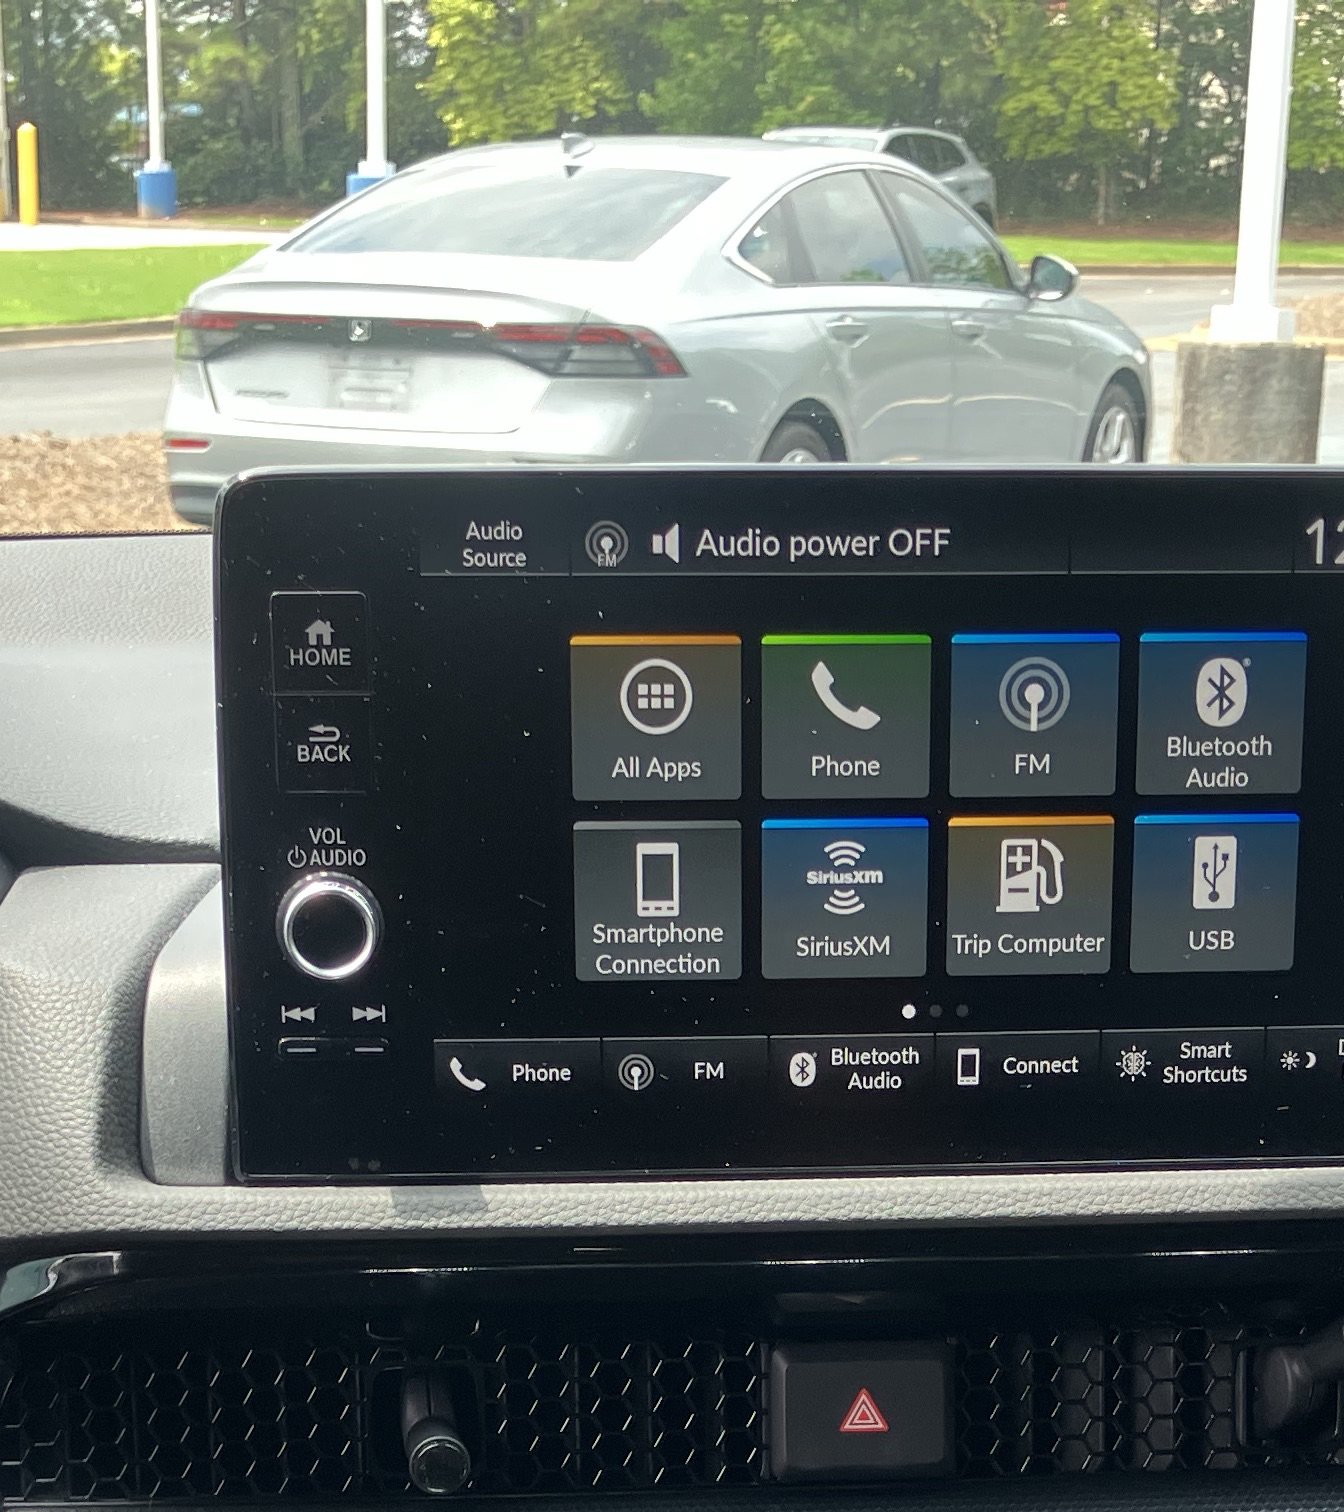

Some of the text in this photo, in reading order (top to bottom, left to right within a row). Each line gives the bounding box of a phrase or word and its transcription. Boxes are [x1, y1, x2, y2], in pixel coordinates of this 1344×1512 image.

[465, 521, 523, 541] Audio
[696, 529, 951, 562] Audio power OFF
[462, 549, 527, 568] Source
[289, 648, 351, 666] HOME
[296, 744, 351, 762] BACK
[1166, 736, 1273, 757] Bluetooth
[611, 757, 701, 782] All Apps
[811, 755, 880, 777] Phone
[1014, 755, 1051, 774] FM
[1185, 767, 1249, 788] Audio
[309, 827, 346, 845] VOL
[310, 849, 366, 866] AUDIO
[592, 924, 724, 947] Smartphone
[952, 932, 1105, 958] Trip Computer
[1188, 930, 1235, 950] USB
[796, 935, 890, 957] SiriusXM
[595, 954, 720, 975] Connection
[831, 1046, 920, 1066] Bluetooth
[1179, 1041, 1232, 1060] Smart
[512, 1063, 571, 1082] Phone
[693, 1061, 724, 1080] FM
[1003, 1056, 1079, 1074] Connect
[1162, 1064, 1248, 1084] Shortcuts
[848, 1072, 902, 1090] Audio
